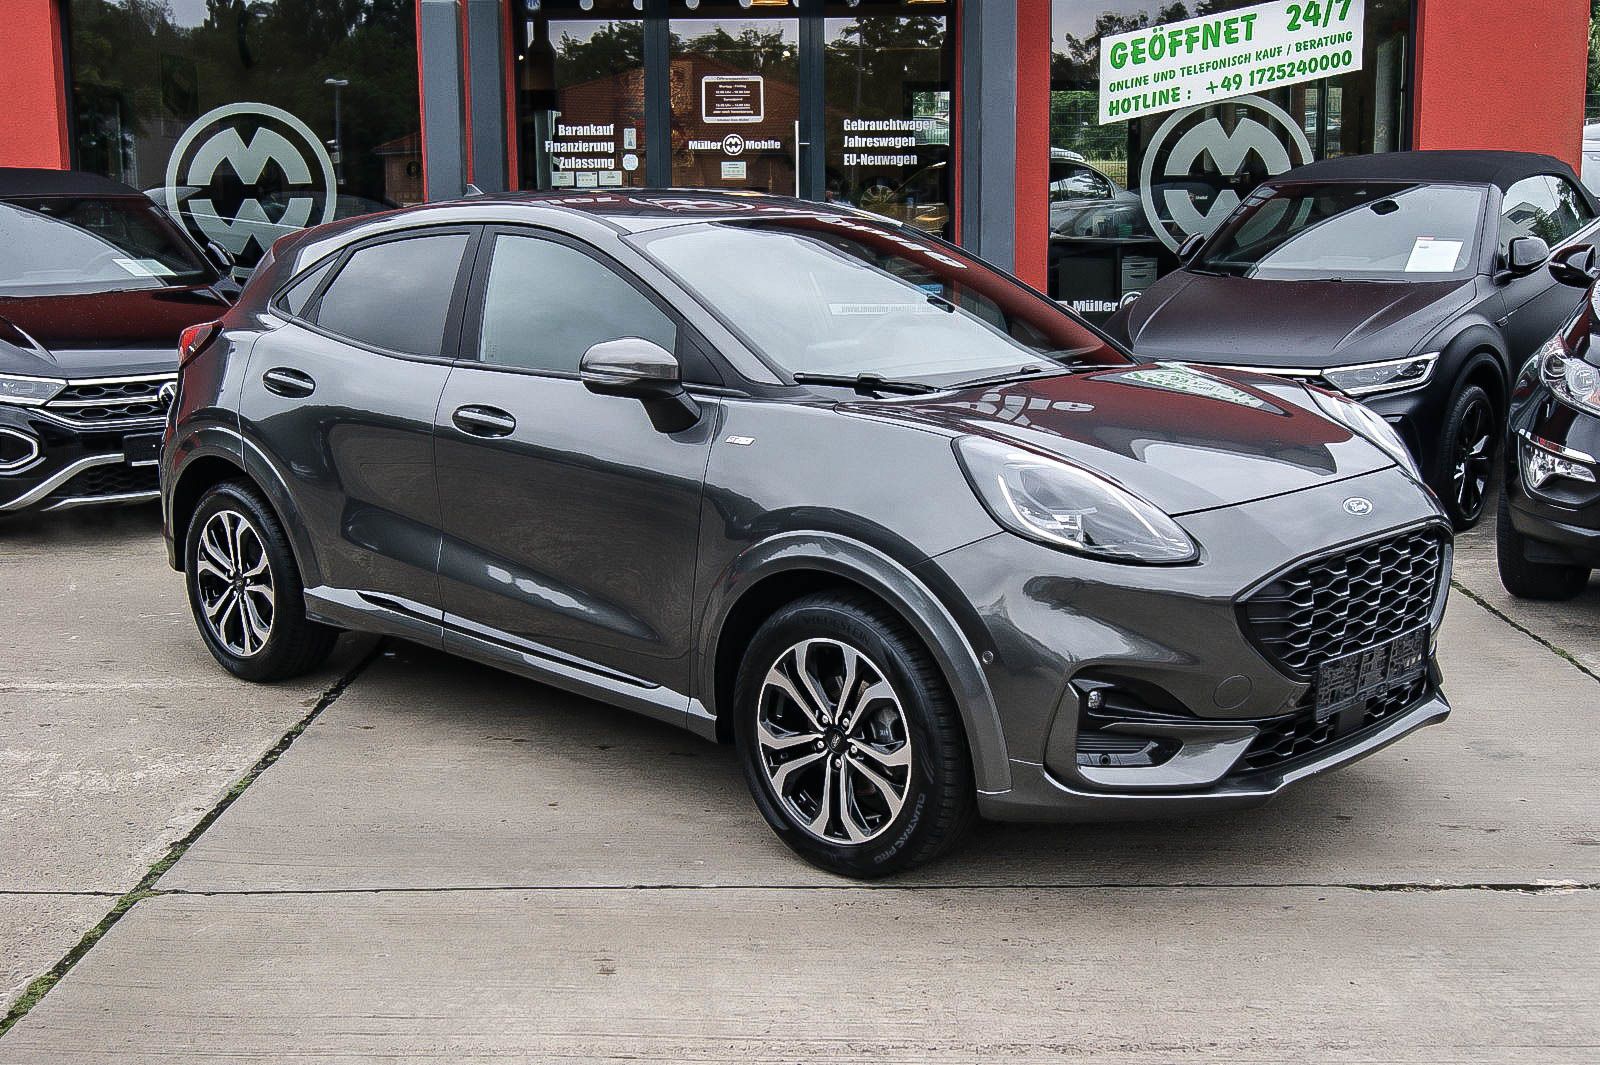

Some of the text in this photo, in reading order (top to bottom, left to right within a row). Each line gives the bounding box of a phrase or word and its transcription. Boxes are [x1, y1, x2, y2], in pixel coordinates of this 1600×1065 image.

[1110, 0, 1351, 69] GEÖFFNET 24/7
[1109, 75, 1150, 93] ONLINE
[1153, 70, 1176, 83] UND
[1180, 54, 1251, 76] TELEFONISCH
[1255, 46, 1283, 62] KAUF
[1295, 31, 1353, 52] BERATUNG
[1206, 73, 1243, 95] +49
[1249, 50, 1353, 87] 1725240000
[558, 123, 615, 136] Barankauf
[843, 118, 936, 132] Gebrauchtwagen
[544, 140, 615, 154] Finanzierung
[688, 139, 781, 150] Müller Mobile
[843, 135, 916, 149] Jahreswagen
[559, 156, 615, 170] Zulassung
[843, 153, 918, 167] EU-Neuwagen
[1073, 299, 1119, 312] Müller
